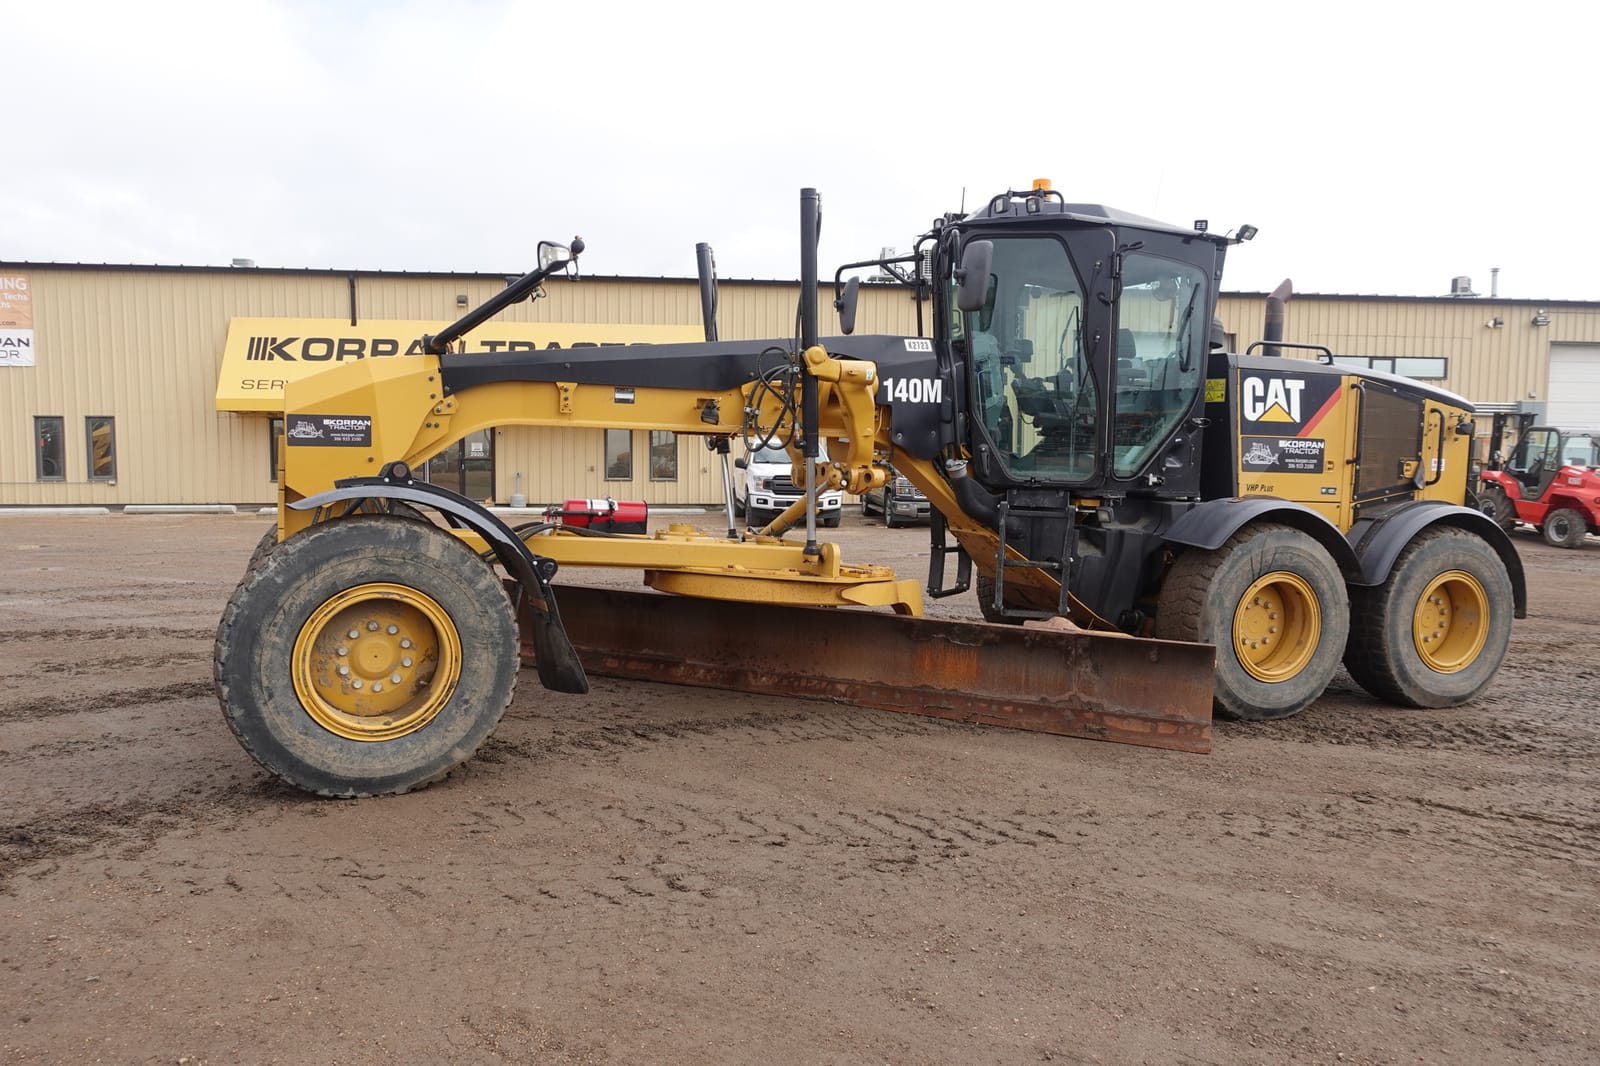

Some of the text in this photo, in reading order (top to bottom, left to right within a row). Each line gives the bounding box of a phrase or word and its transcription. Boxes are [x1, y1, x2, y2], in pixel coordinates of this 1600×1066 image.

[883, 377, 942, 403] 140M
[1243, 376, 1305, 423] CAT
[323, 418, 371, 426] KORPAN
[1279, 440, 1324, 448] KORPAN
[1284, 447, 1320, 455] TRACTOR
[1246, 483, 1260, 492] VHP
